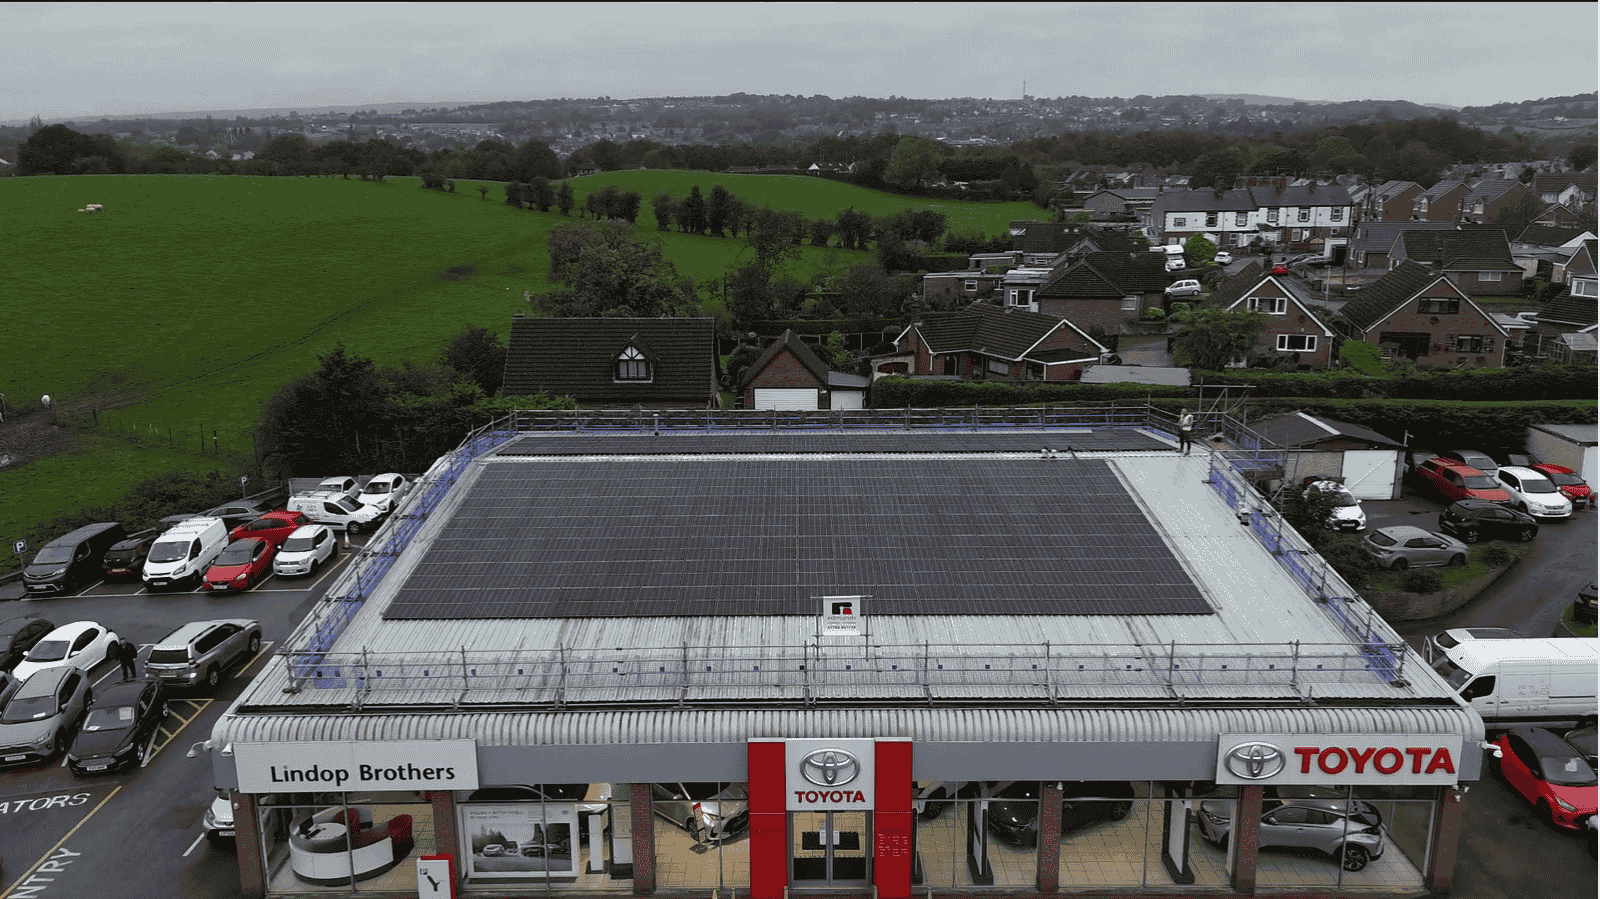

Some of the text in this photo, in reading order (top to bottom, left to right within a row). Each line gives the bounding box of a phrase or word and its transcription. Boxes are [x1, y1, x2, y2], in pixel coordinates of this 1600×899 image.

[16, 541, 24, 552] P
[1293, 746, 1456, 775] TOYOTA
[270, 763, 456, 787] Lindop Brothers
[794, 790, 866, 803] TOYOTA
